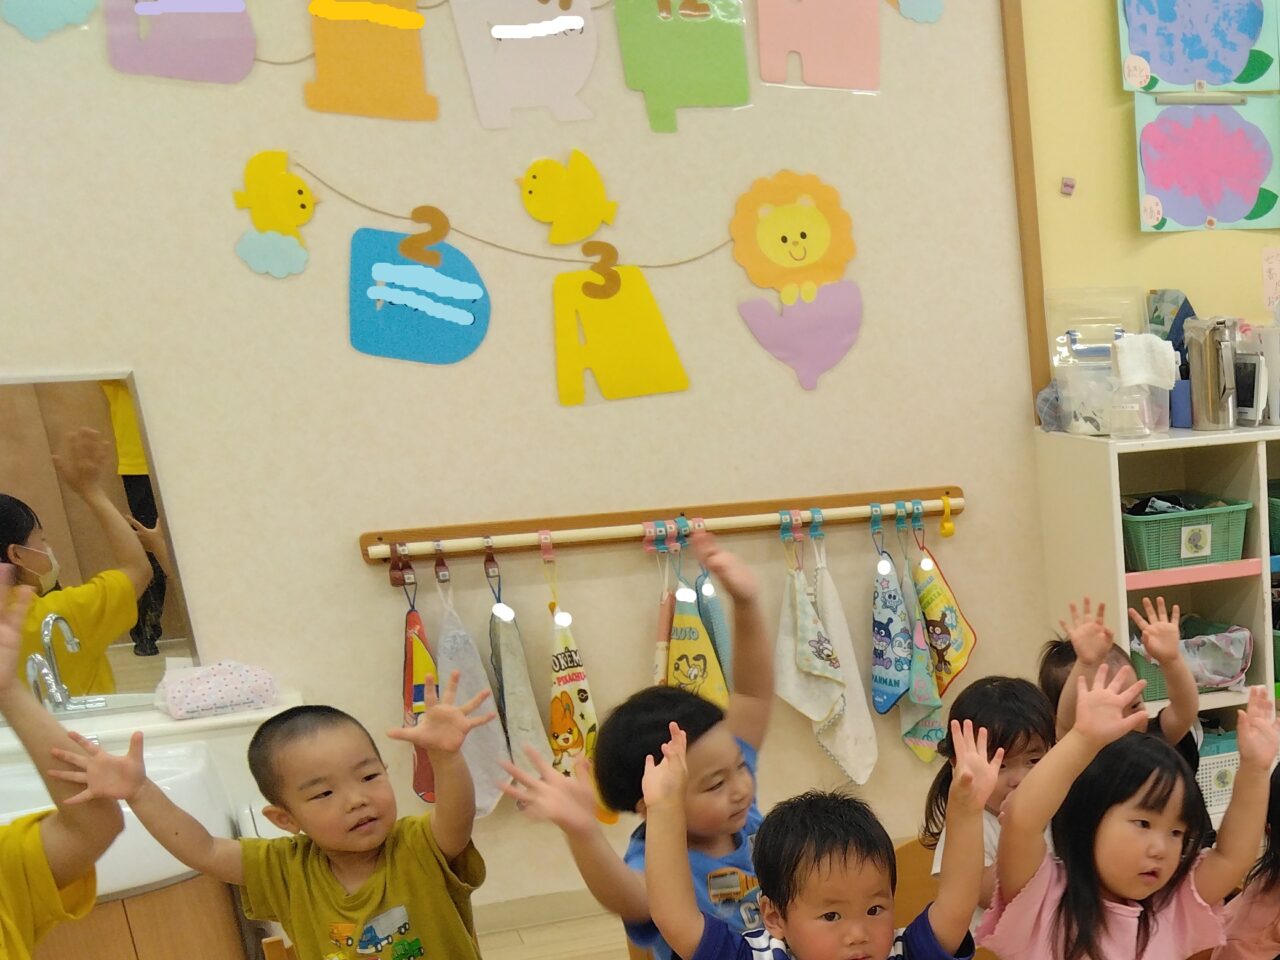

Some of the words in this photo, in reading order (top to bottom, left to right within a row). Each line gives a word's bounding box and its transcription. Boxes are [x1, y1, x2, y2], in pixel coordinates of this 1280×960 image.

[398, 205, 450, 267] 2
[581, 240, 621, 299] 3
[552, 646, 583, 673] OKÉM
